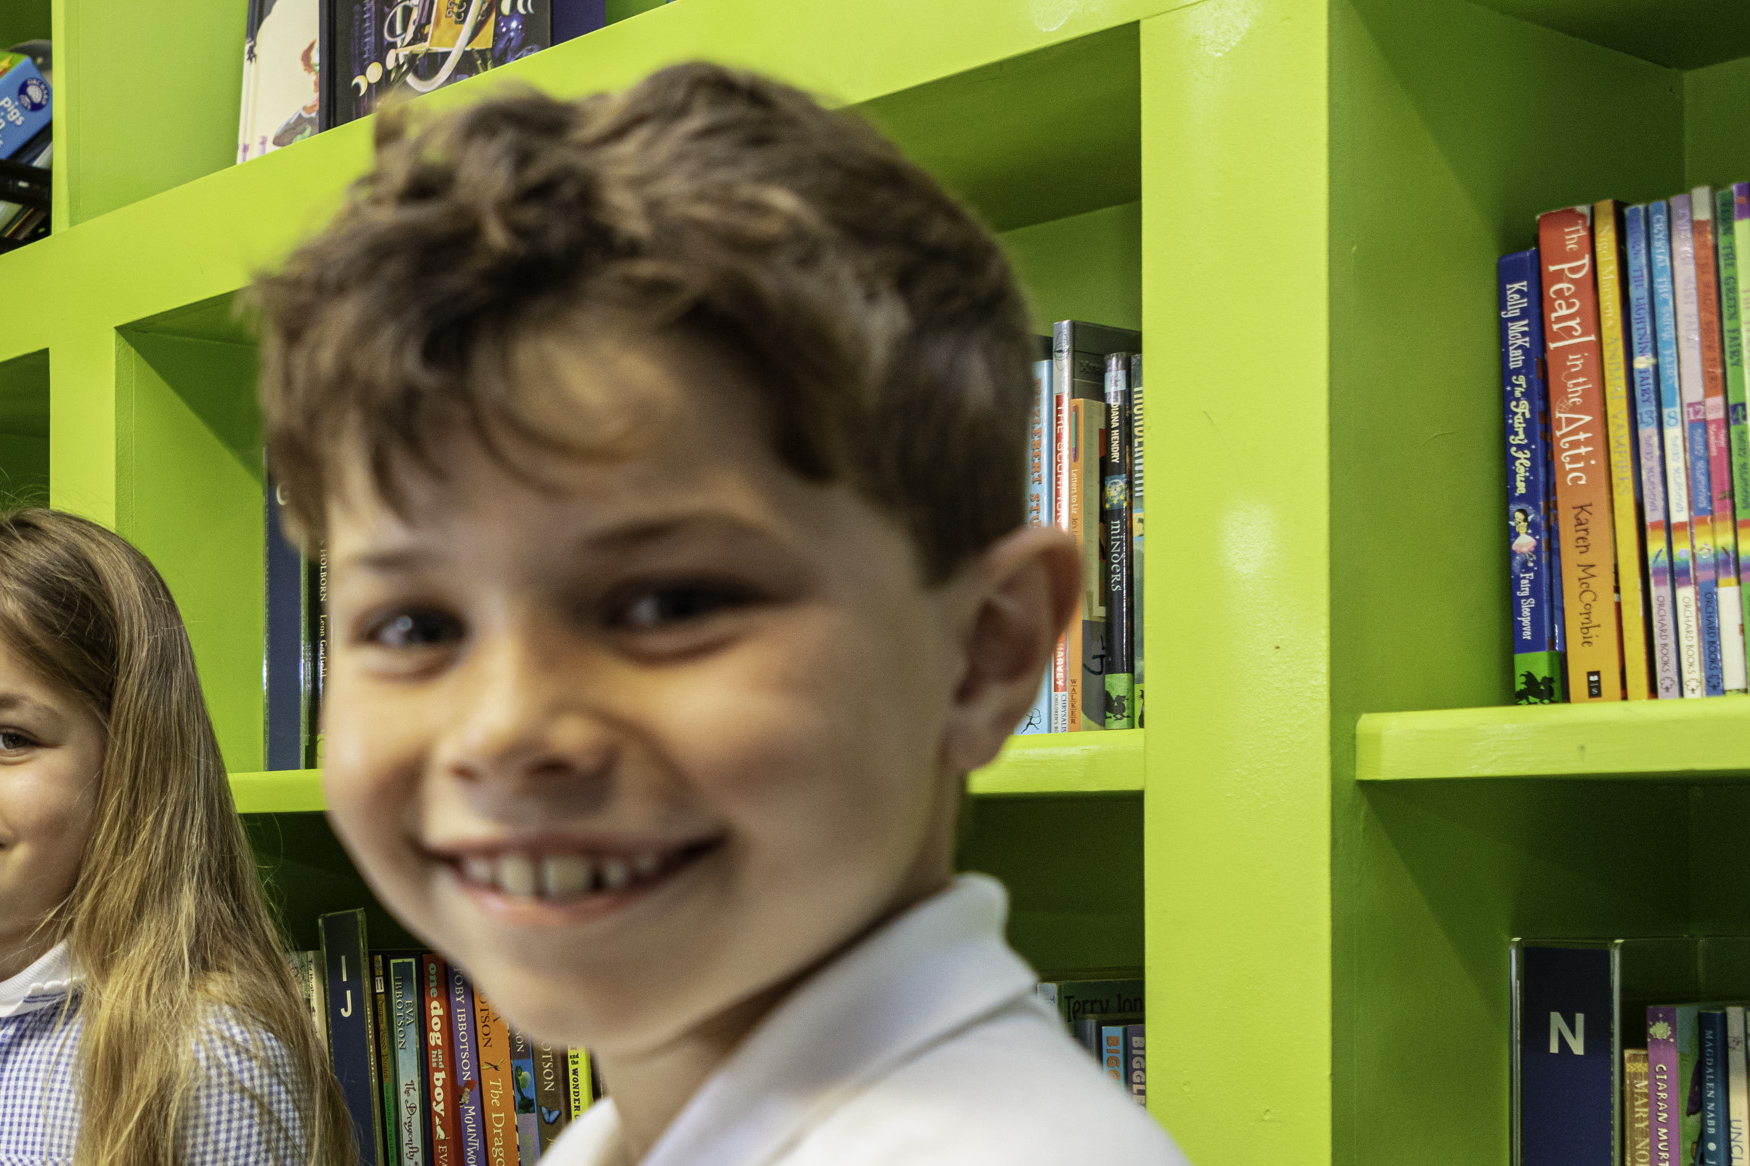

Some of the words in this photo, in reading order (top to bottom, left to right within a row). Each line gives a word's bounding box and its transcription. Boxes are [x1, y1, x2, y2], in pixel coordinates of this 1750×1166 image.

[1563, 220, 1587, 252] The
[1500, 281, 1528, 318] Kelly
[1548, 254, 1596, 350] Pearl
[1725, 276, 1739, 320] GREEN
[1508, 319, 1529, 369] McKain
[1567, 352, 1588, 371] in
[1110, 402, 1120, 426] DIANA
[1566, 377, 1592, 407] the
[1509, 400, 1530, 445] Fairy
[1110, 428, 1120, 463] HENDRY
[1554, 411, 1596, 487] Attic
[1070, 468, 1079, 494] Letters
[1070, 503, 1079, 515] Liz
[1571, 502, 1593, 555] Karen
[1110, 520, 1123, 592] minders
[1517, 571, 1534, 597] Fairy
[1577, 563, 1601, 648] McCombie
[1520, 598, 1535, 640] Sleepover
[1656, 595, 1666, 641] ORCHARD
[1682, 596, 1694, 643] ORCHARD
[320, 640, 328, 677] Garfield
[1660, 642, 1670, 674] BOOKS
[1687, 644, 1697, 675] BOOKS
[1070, 678, 1078, 724] WALKER
[428, 962, 438, 999] one
[340, 990, 352, 1018] J
[394, 975, 406, 1050] IBBOTSON
[405, 999, 415, 1026] EVA
[428, 1001, 444, 1047] dog
[456, 1004, 471, 1081] IBBOTSON
[1549, 1011, 1586, 1056] N
[1705, 1030, 1715, 1098] MAGDALEN
[431, 1071, 446, 1117] boy
[488, 1077, 503, 1109] The
[571, 1067, 581, 1112] WONDER
[1634, 1079, 1650, 1129] MARY
[1656, 1063, 1669, 1123] CIARAN
[403, 1099, 420, 1160] Dragonfly
[1707, 1102, 1716, 1134] NABB
